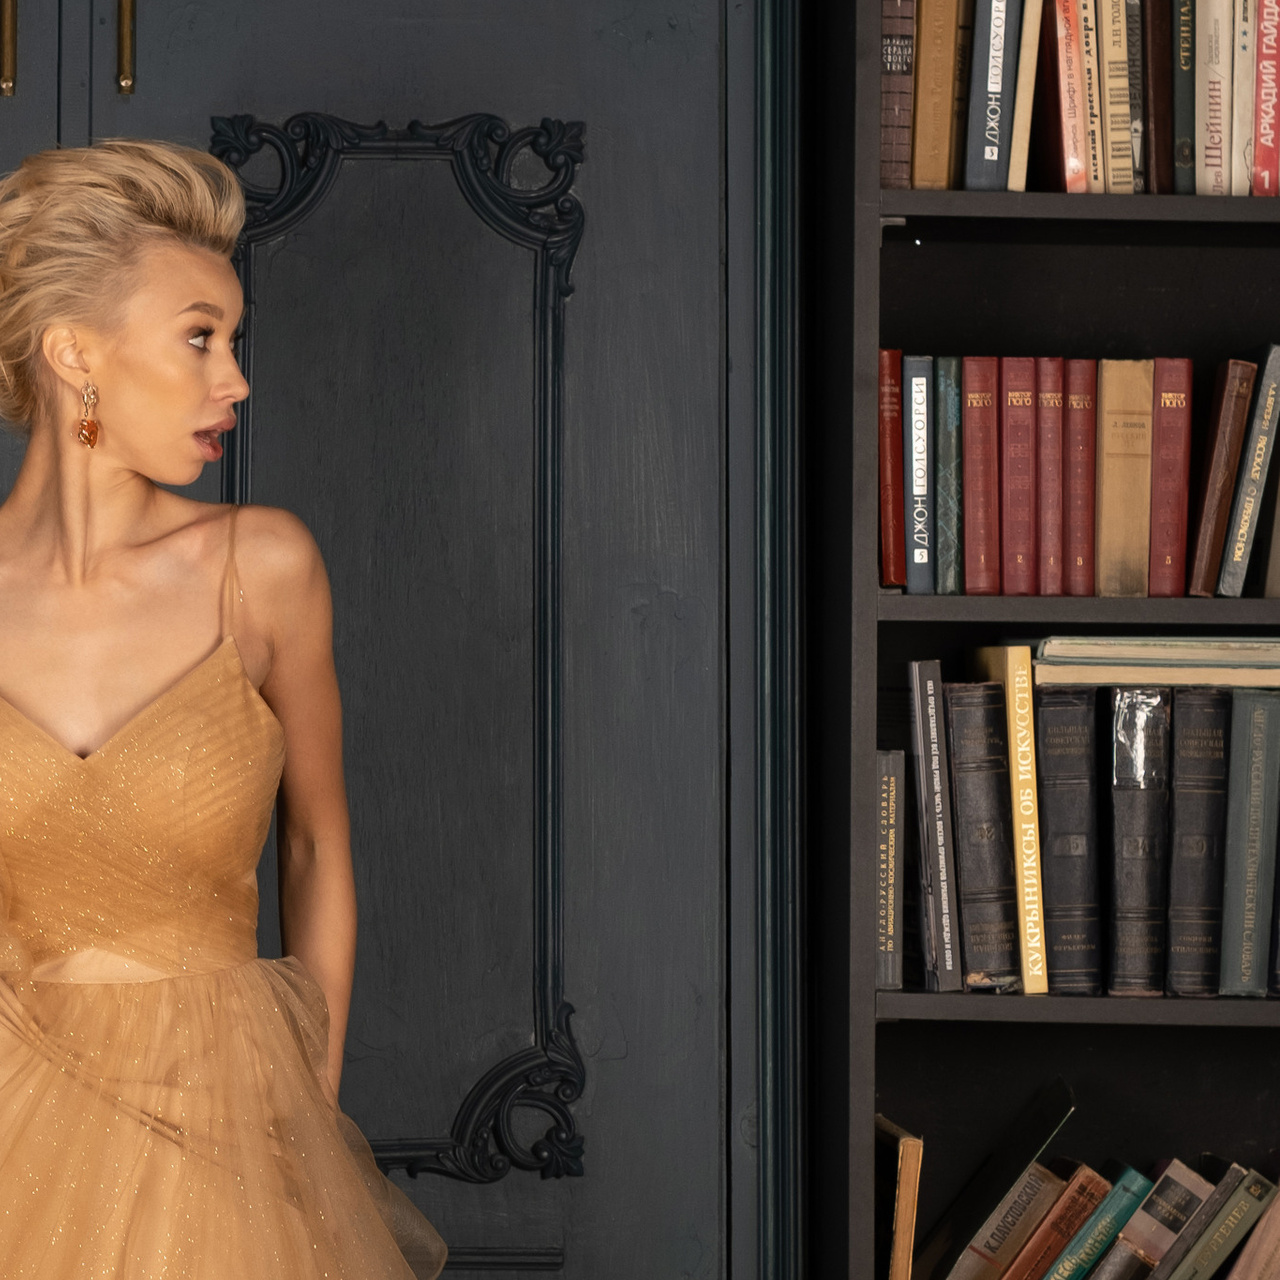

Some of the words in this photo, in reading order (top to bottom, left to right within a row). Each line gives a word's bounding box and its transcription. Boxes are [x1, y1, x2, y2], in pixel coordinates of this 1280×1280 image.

[1062, 16, 1075, 71] наглядной
[985, 93, 1001, 145] ДЖОН
[1066, 81, 1078, 119] Шрифт
[1205, 80, 1223, 169] Шейнин
[1260, 60, 1277, 148] АРКАДИЙ
[1212, 170, 1223, 193] Лев
[1260, 170, 1270, 189] 1
[913, 379, 927, 495] ГОЛСУОРСИ
[913, 496, 928, 546] ДЖОН
[1016, 555, 1023, 564] 2
[927, 696, 938, 742] ПРЕДСТАВЛЯЕТ
[1013, 662, 1034, 782] ИСКУССТВЕ
[931, 755, 940, 768] ПОД
[880, 775, 888, 835] СЛОВАРЬ
[888, 775, 896, 825] МАТЕРИАЛАМ
[934, 793, 943, 812] ЧАСТЬ
[1018, 787, 1035, 816] ОБ
[887, 828, 896, 937] АВИАЦИОННО-КОСМИЧЕСКИМ
[936, 846, 948, 880] ПРИМЕРОВ
[879, 843, 888, 953] АНГЛО-РУССКИЙ
[939, 881, 950, 913] ХРАНЕНИЯ
[1020, 822, 1044, 977] КУКРЫНИКСЫ
[887, 940, 894, 952] ПО
[941, 914, 951, 942] ОДЕЖДЫ
[1240, 929, 1254, 983] СЛОВАРЬ
[983, 1172, 1047, 1255] К.ПАУСТОВСКИЙ
[1197, 1199, 1251, 1267] ТУРГЕНЕВ
